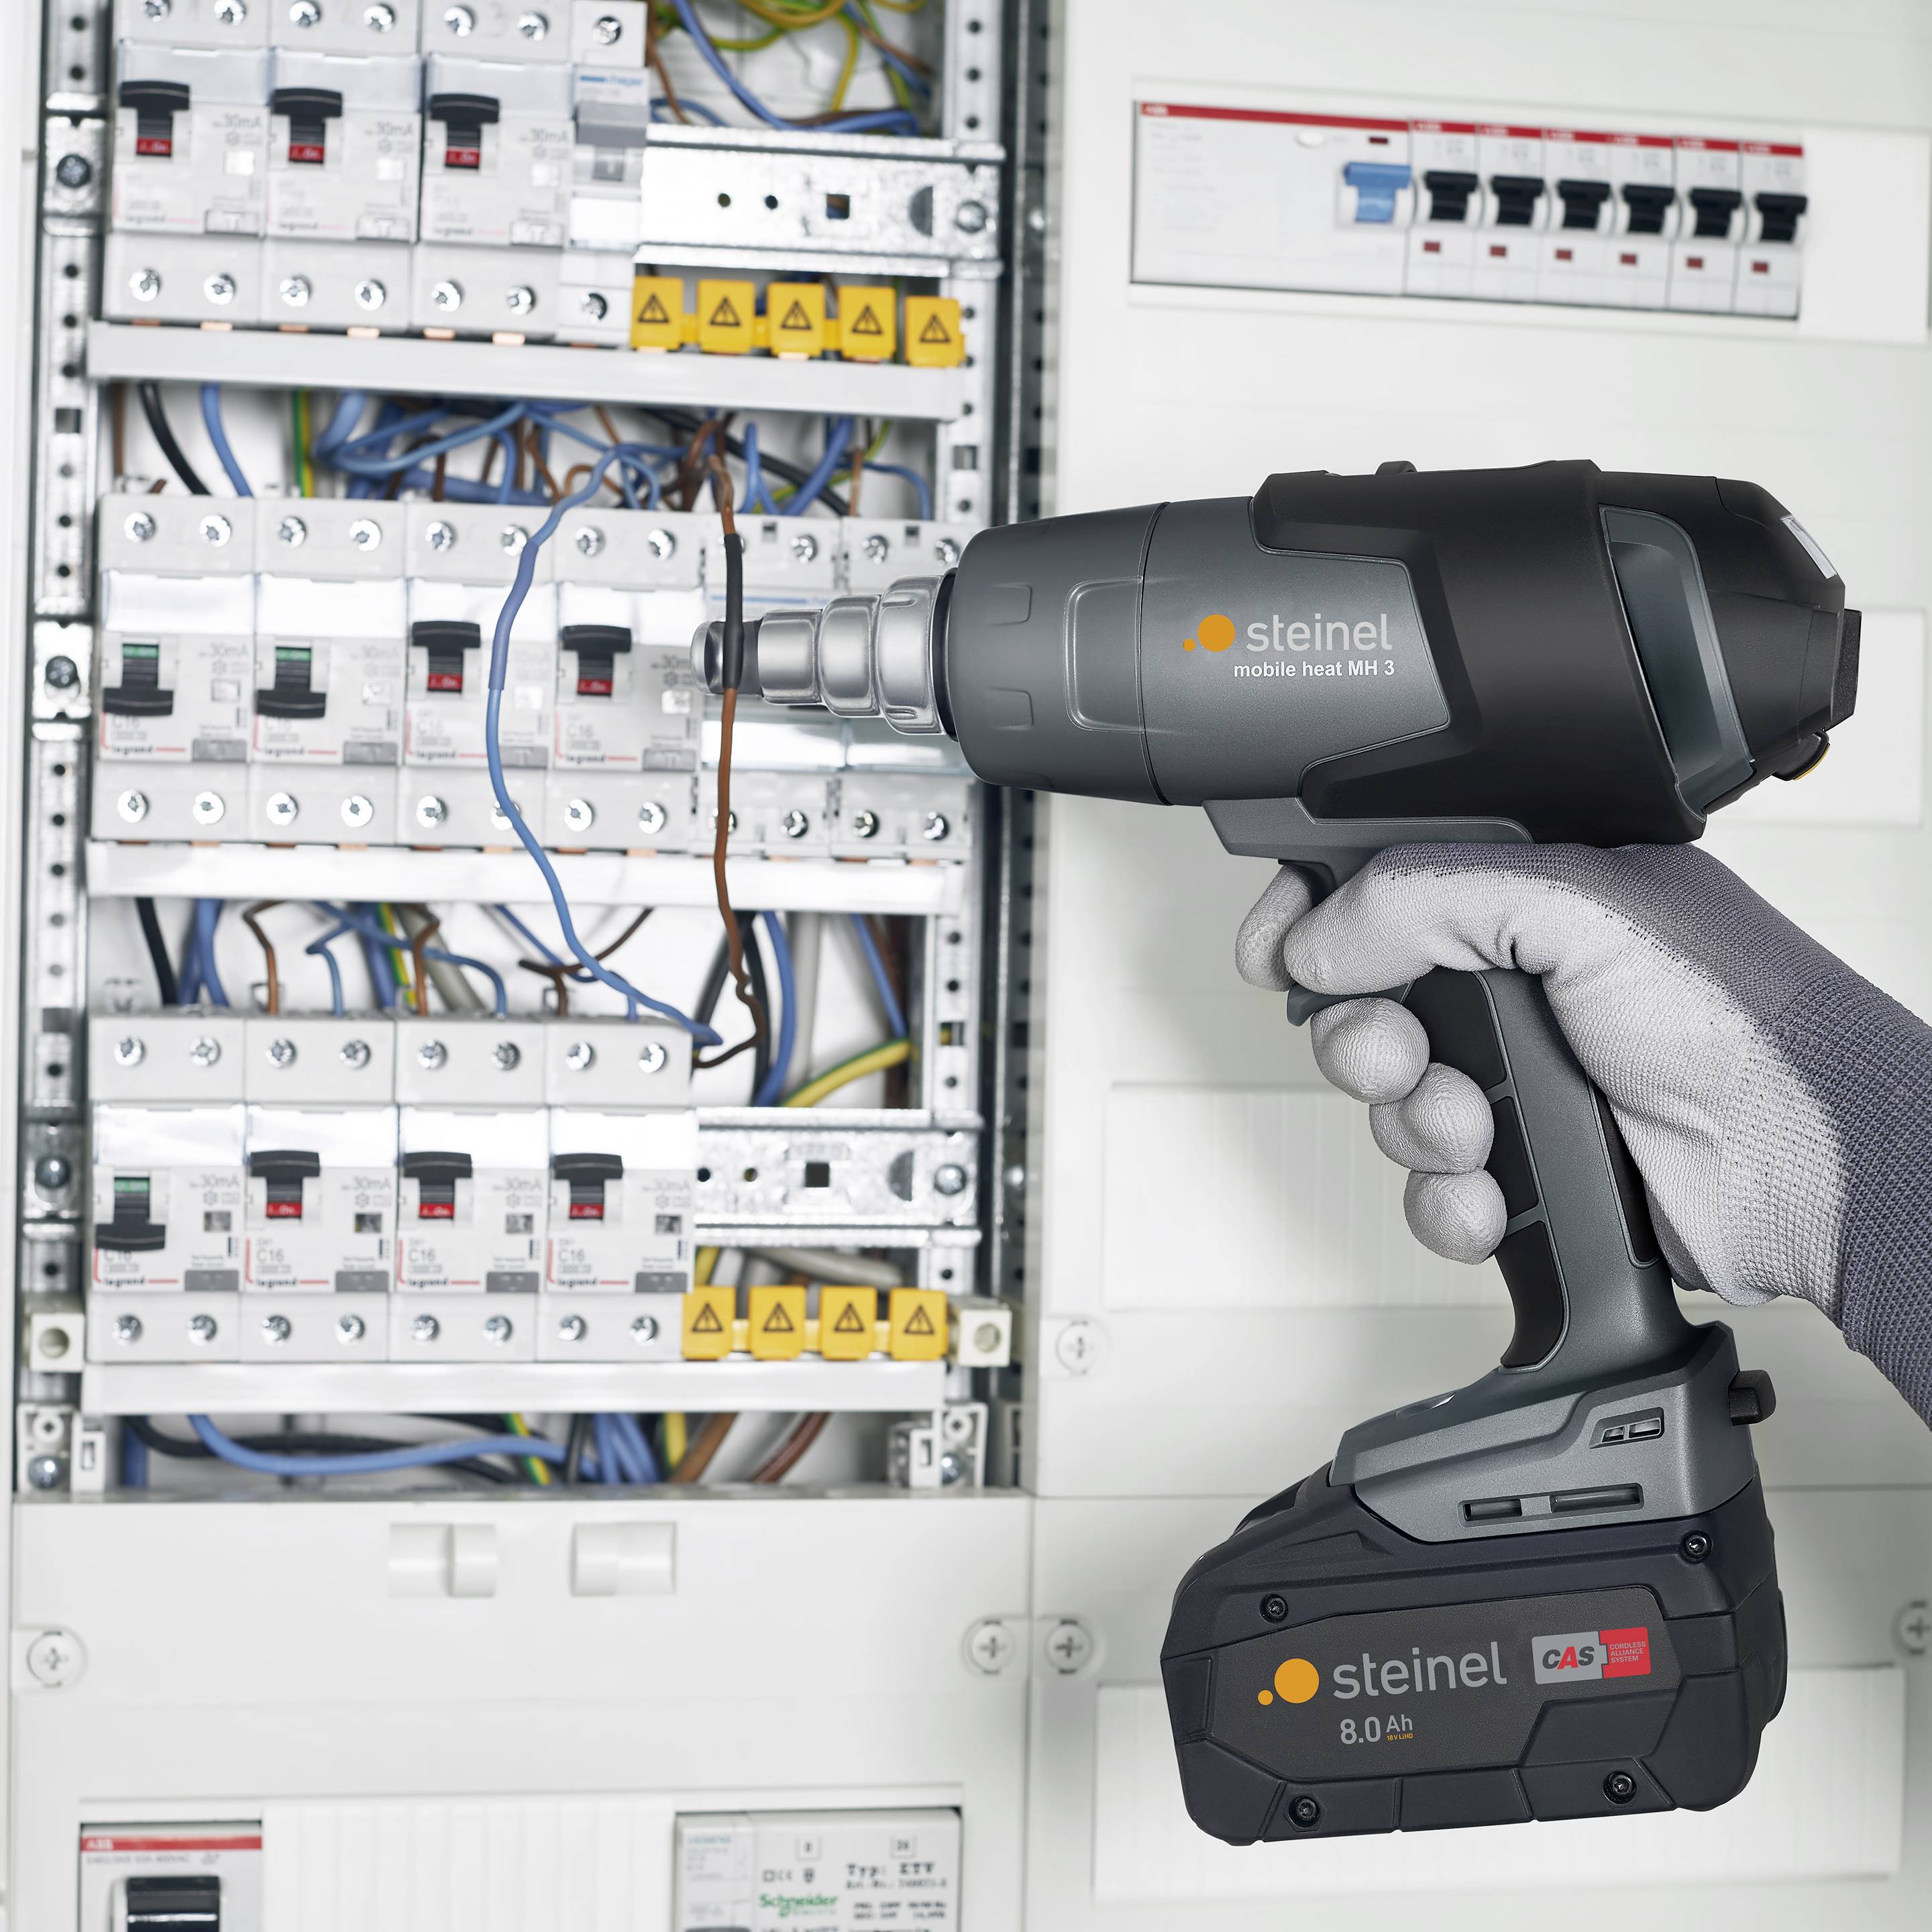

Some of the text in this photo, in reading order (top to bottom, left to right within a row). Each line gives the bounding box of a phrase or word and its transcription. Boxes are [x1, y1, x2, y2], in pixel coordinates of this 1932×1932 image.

[1246, 613, 1393, 652] steinel
[1234, 659, 1395, 678] mobile heat MH 3
[104, 1277, 146, 1287] legrand
[256, 1277, 297, 1288] legrand
[408, 1277, 447, 1288] legrand
[557, 1277, 597, 1289] legrand
[1610, 1641, 1646, 1650] CORDLESS
[1542, 1646, 1595, 1670] CAS
[1610, 1648, 1644, 1657] ALLIANCE
[1611, 1655, 1639, 1664] SYSTEM
[1333, 1641, 1507, 1700] steinel
[1340, 1713, 1413, 1745] 8.0 Ah
[760, 1892, 839, 1918] Schneider
